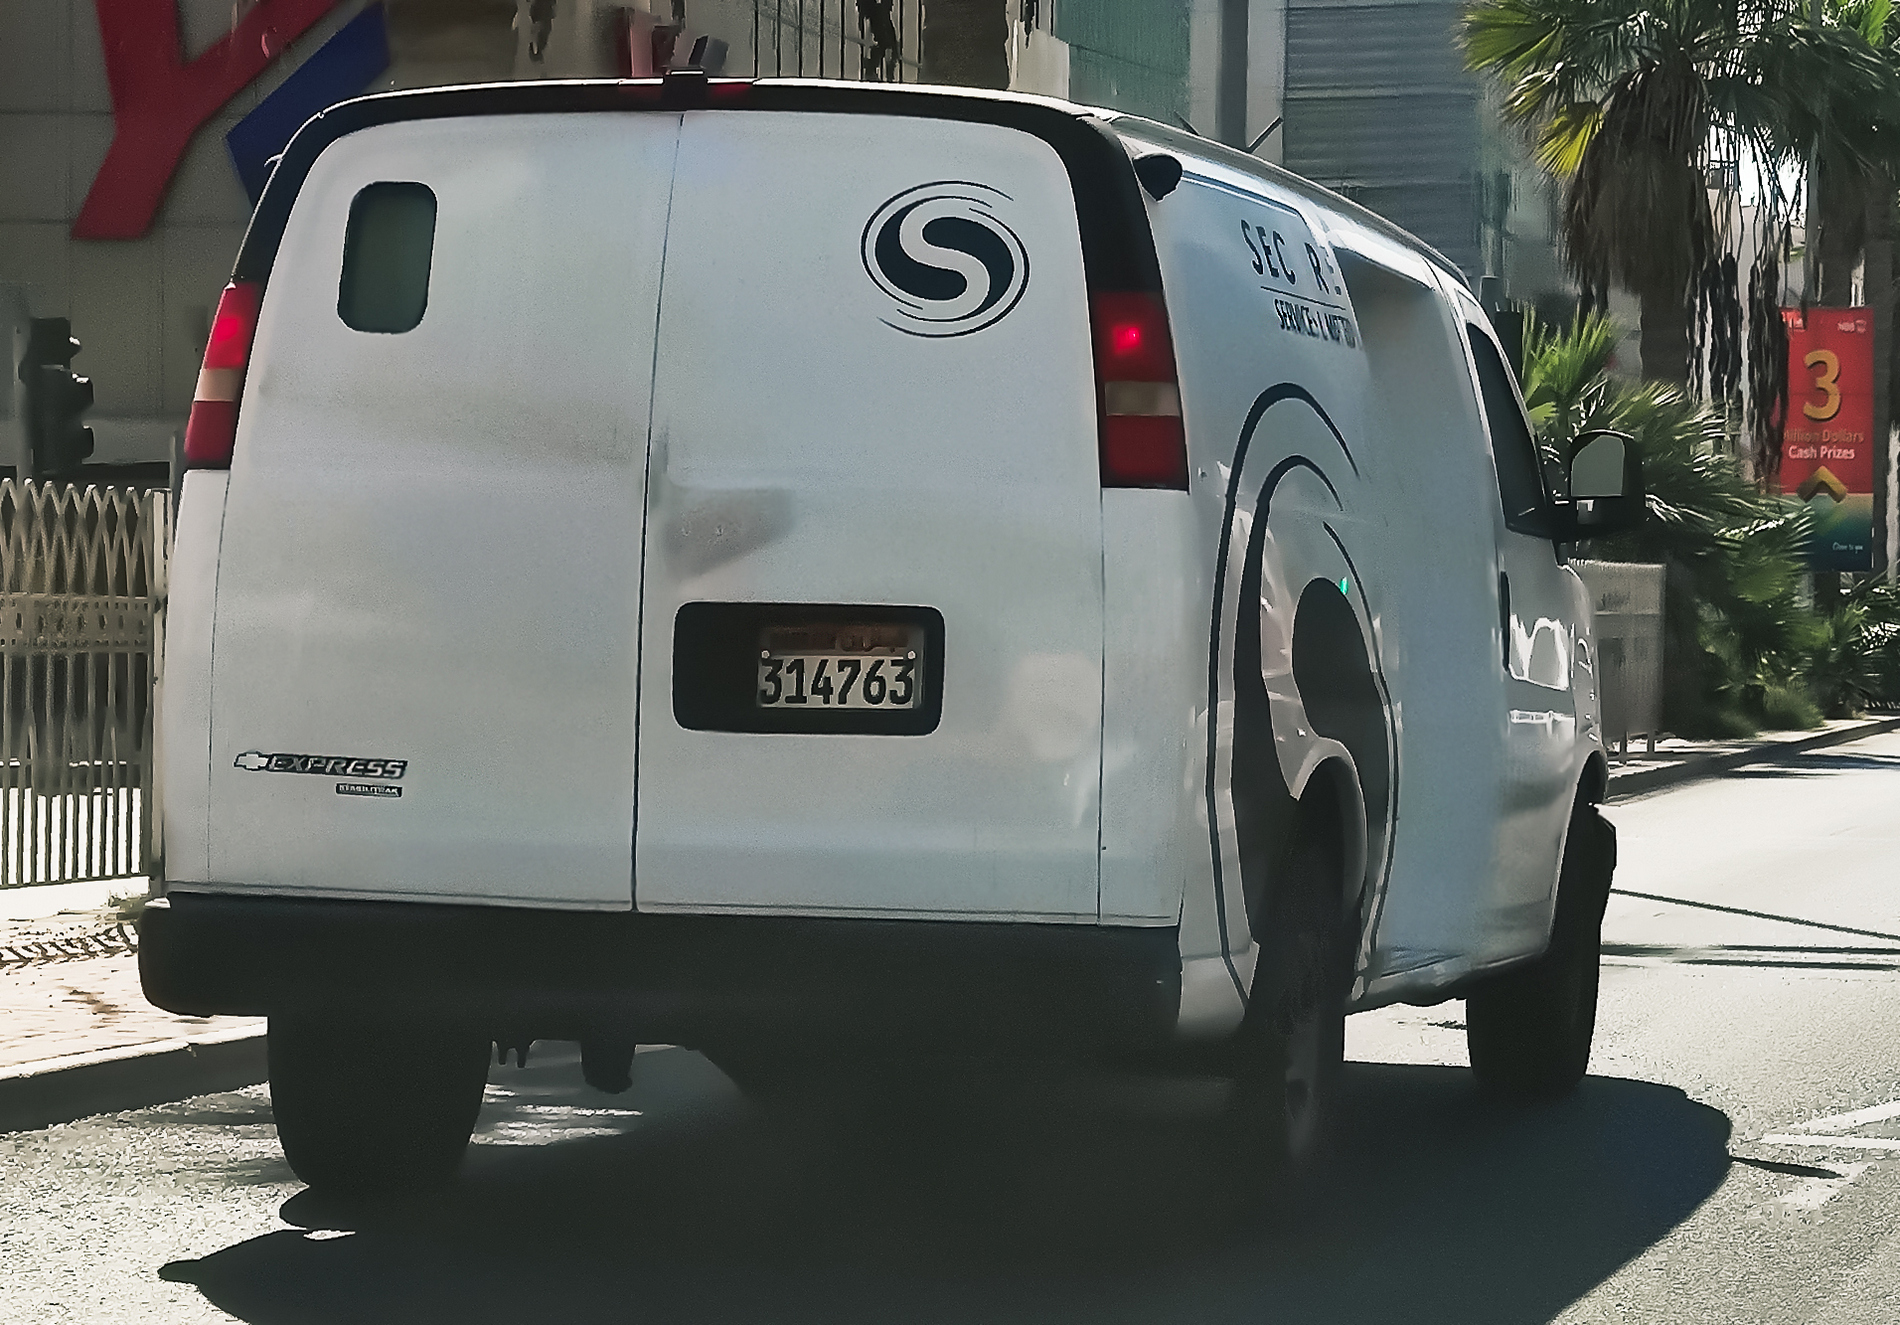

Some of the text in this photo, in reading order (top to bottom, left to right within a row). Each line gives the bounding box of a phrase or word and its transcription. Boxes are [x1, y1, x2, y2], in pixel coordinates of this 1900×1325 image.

[1803, 349, 1841, 422] 3
[1788, 445, 1855, 459] Cash Prizes
[760, 658, 914, 705] 314763
[267, 755, 404, 778] EXPRESS
